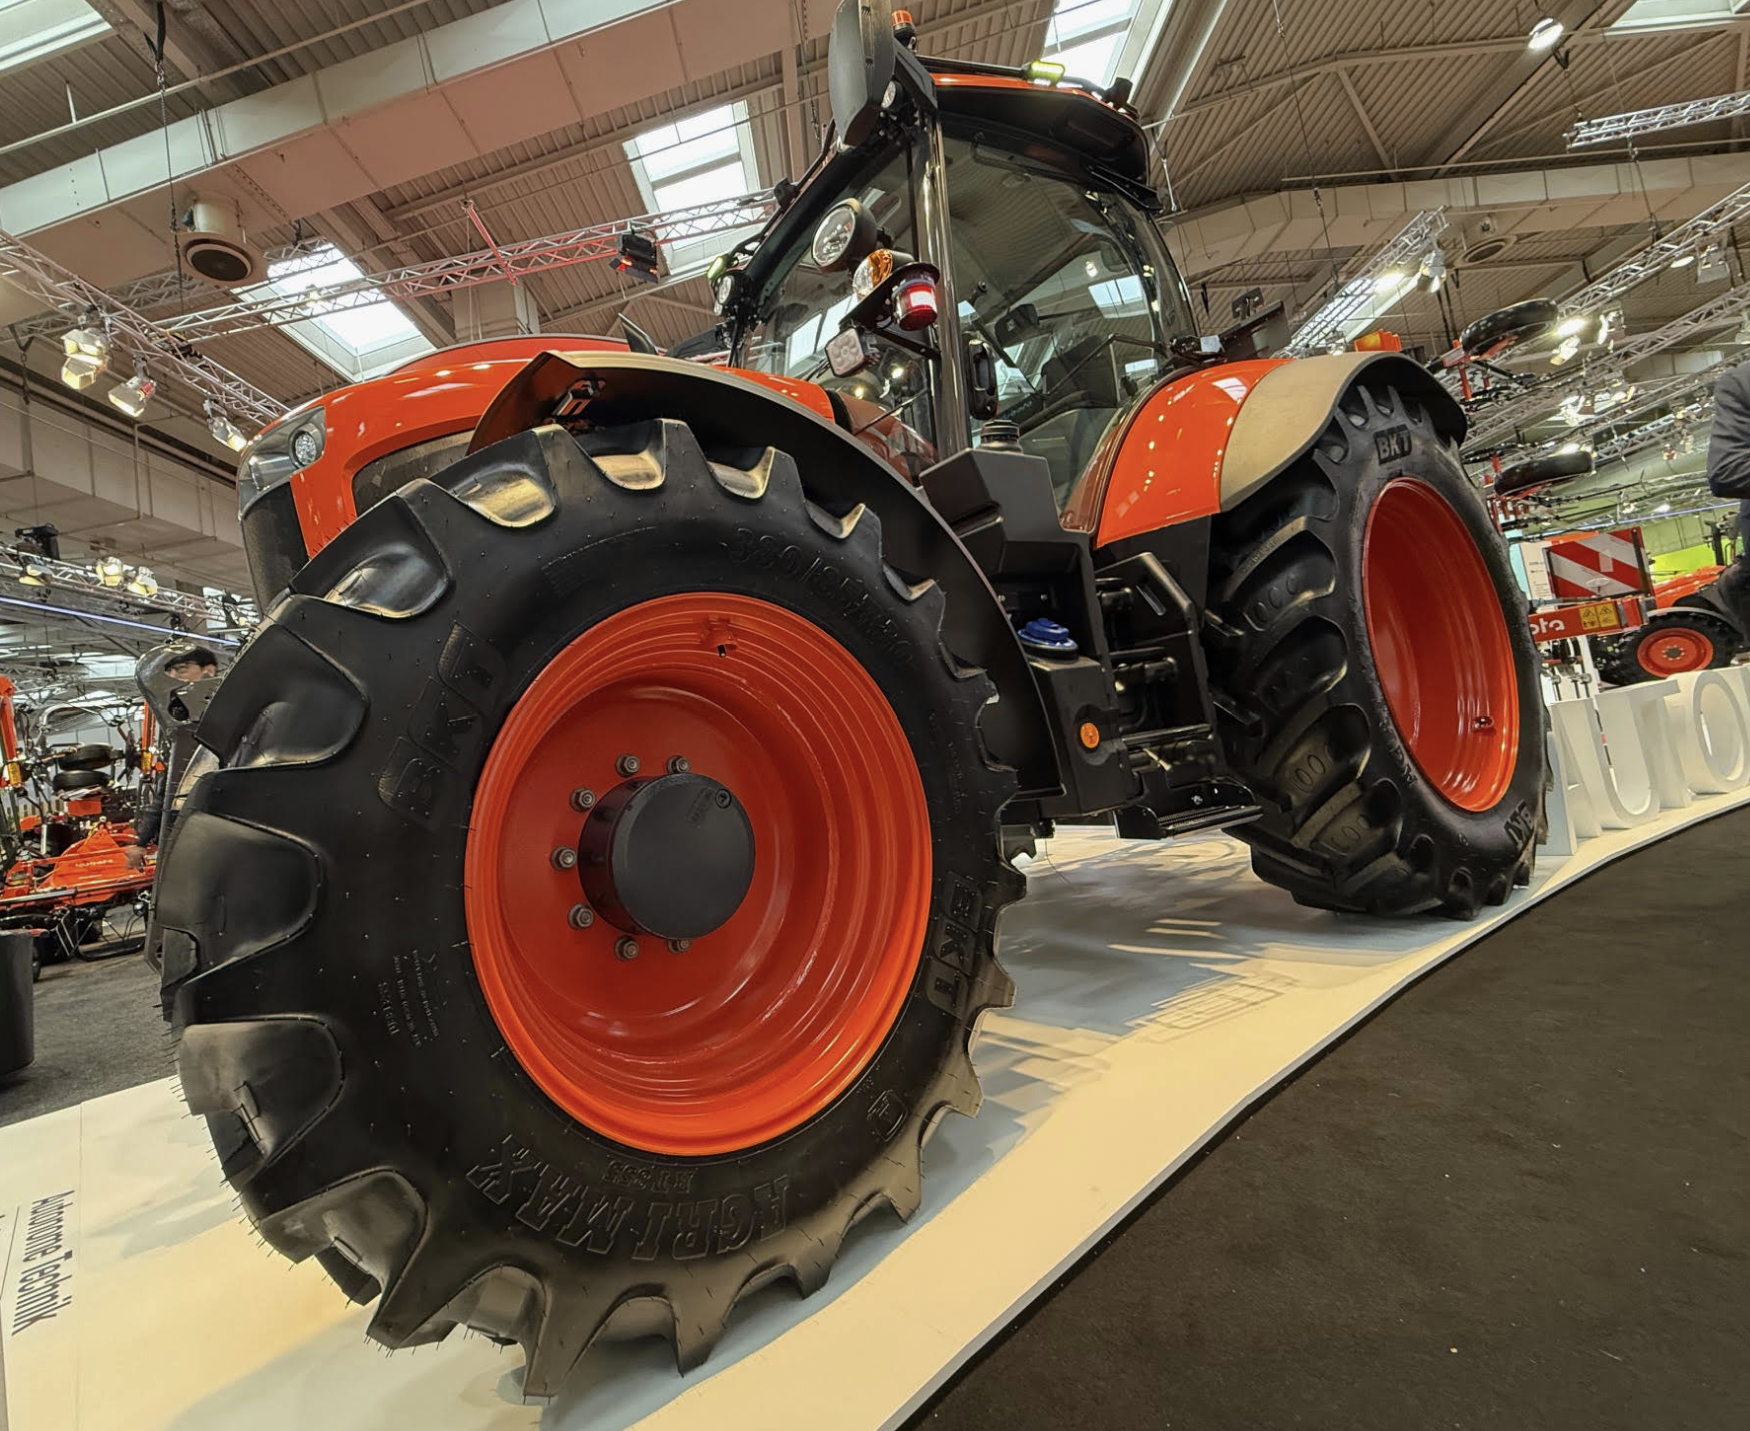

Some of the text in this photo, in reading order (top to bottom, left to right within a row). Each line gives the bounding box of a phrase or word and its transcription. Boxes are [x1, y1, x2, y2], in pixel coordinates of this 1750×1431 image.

[1374, 426, 1411, 462] BKT
[1536, 664, 1750, 857] AUTO
[930, 875, 979, 1012] BKT
[11, 1189, 75, 1337] Autonome Technik
